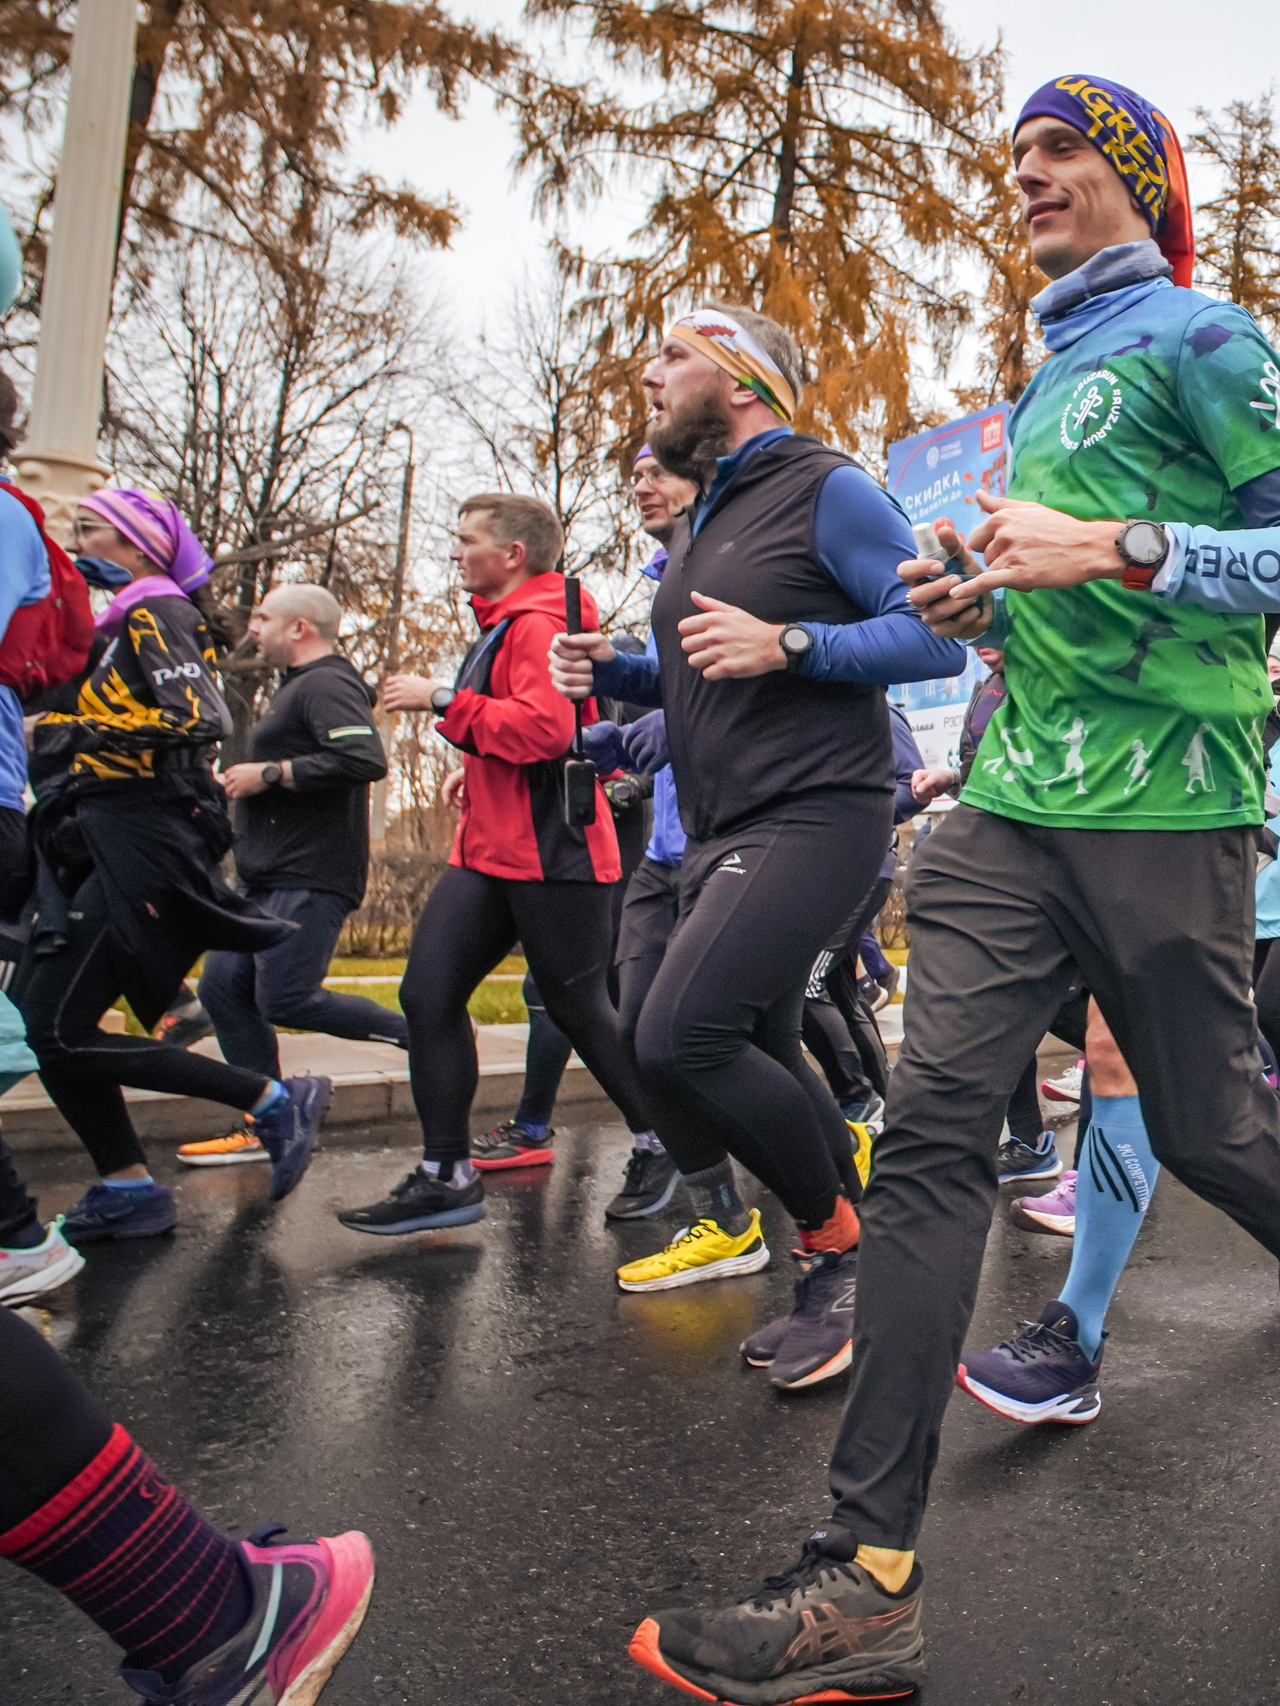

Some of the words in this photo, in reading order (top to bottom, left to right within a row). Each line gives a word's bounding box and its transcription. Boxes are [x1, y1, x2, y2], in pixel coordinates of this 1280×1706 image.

[1055, 76, 1168, 198] UGRES
[1082, 387, 1123, 449] #RUZARUN
[905, 470, 961, 510] СКИДКА
[950, 489, 962, 501] до
[1116, 1143, 1137, 1158] SKI
